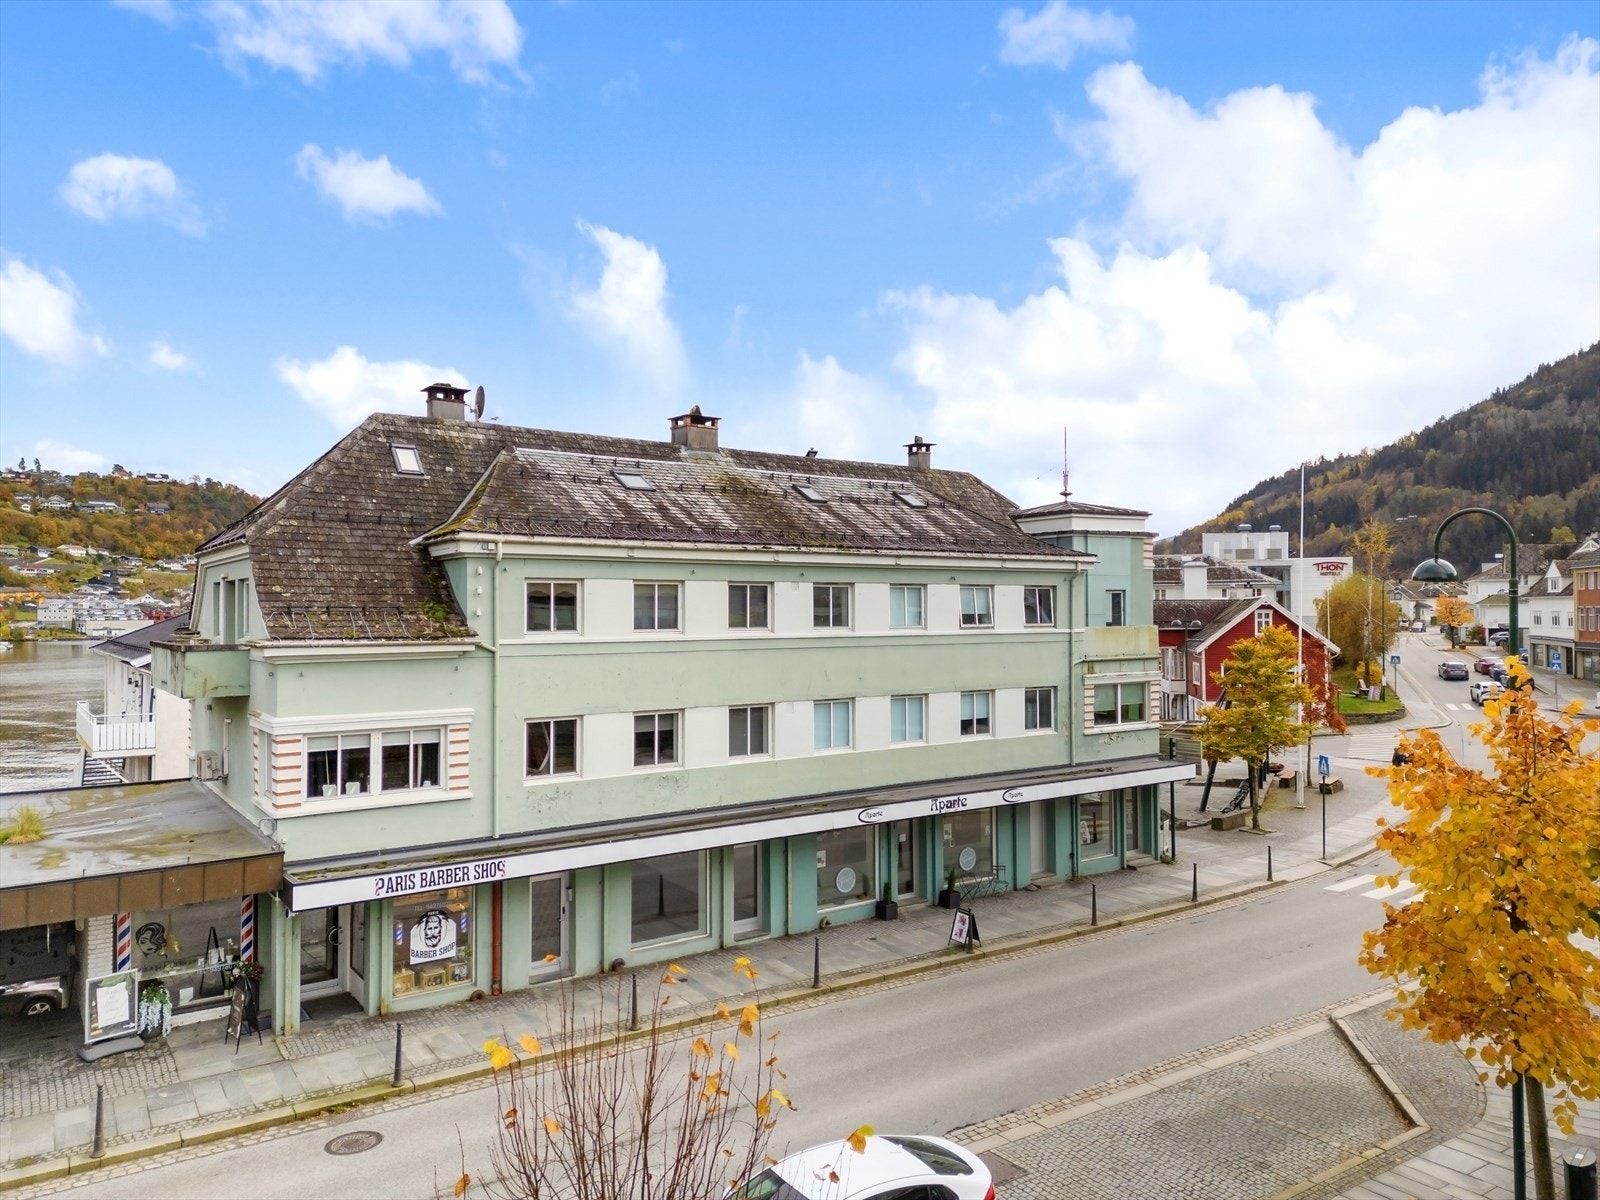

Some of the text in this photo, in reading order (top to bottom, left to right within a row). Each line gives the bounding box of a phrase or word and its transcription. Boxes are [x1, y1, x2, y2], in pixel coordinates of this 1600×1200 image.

[1314, 562, 1346, 571] THON
[930, 797, 968, 814] Aparte
[375, 873, 416, 896] PARIS
[420, 866, 470, 888] BARBER
[411, 941, 456, 959] BARBER SHOP
